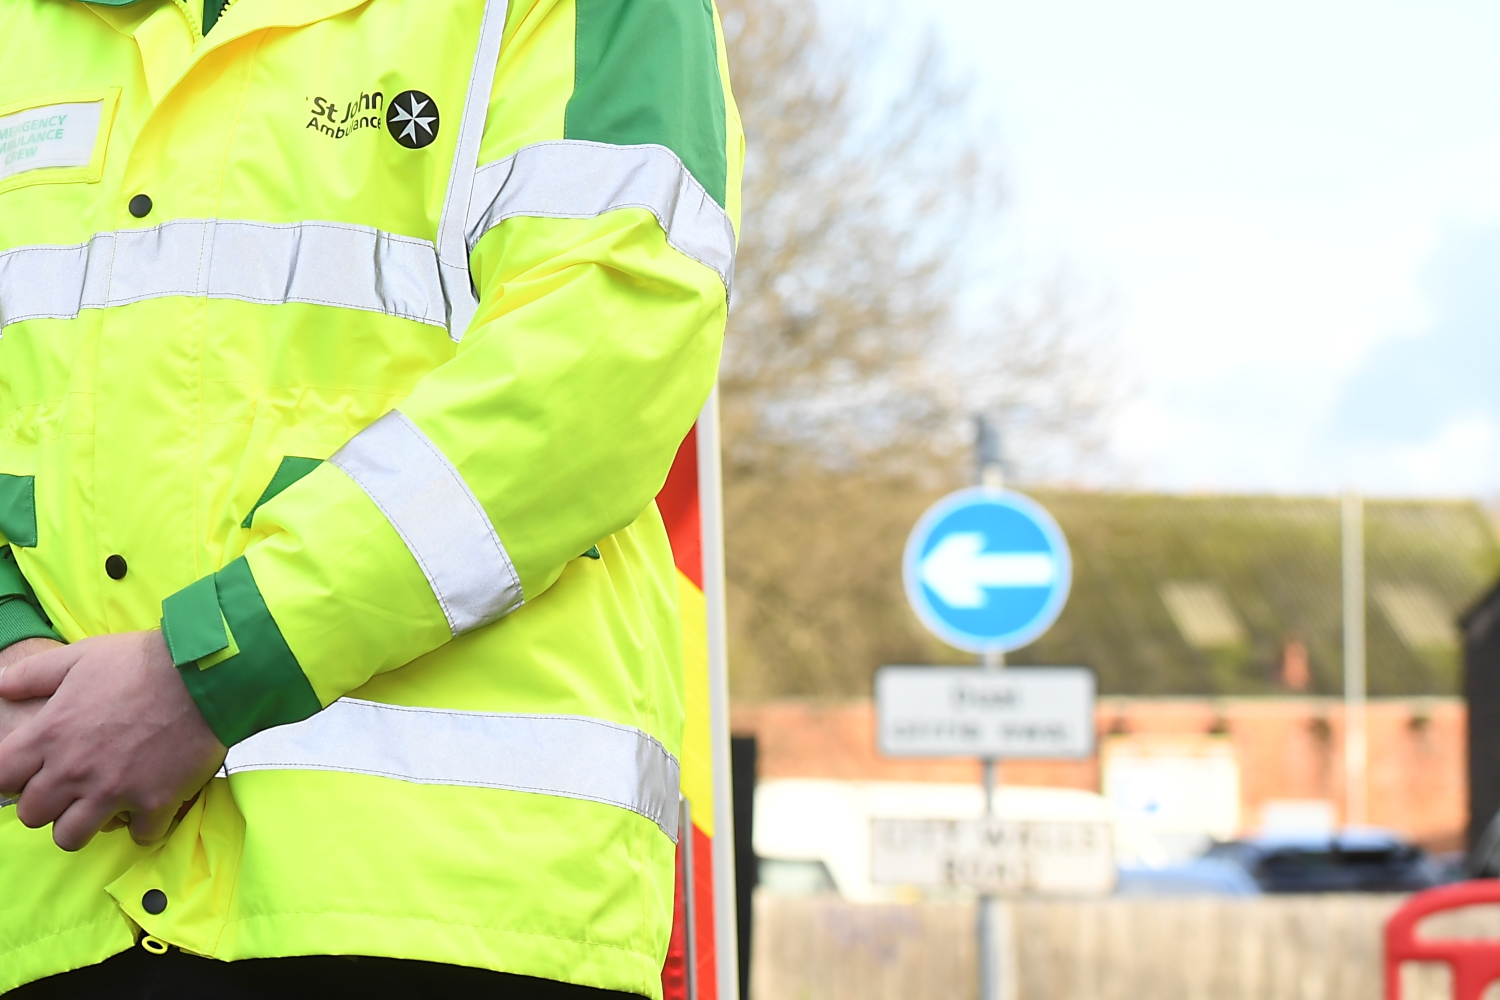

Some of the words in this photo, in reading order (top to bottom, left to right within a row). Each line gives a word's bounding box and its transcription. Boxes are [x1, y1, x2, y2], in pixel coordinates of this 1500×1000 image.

[310, 96, 338, 123] St
[340, 91, 384, 124] John
[306, 116, 382, 139] Ambulance
[4, 146, 39, 165] CREW
